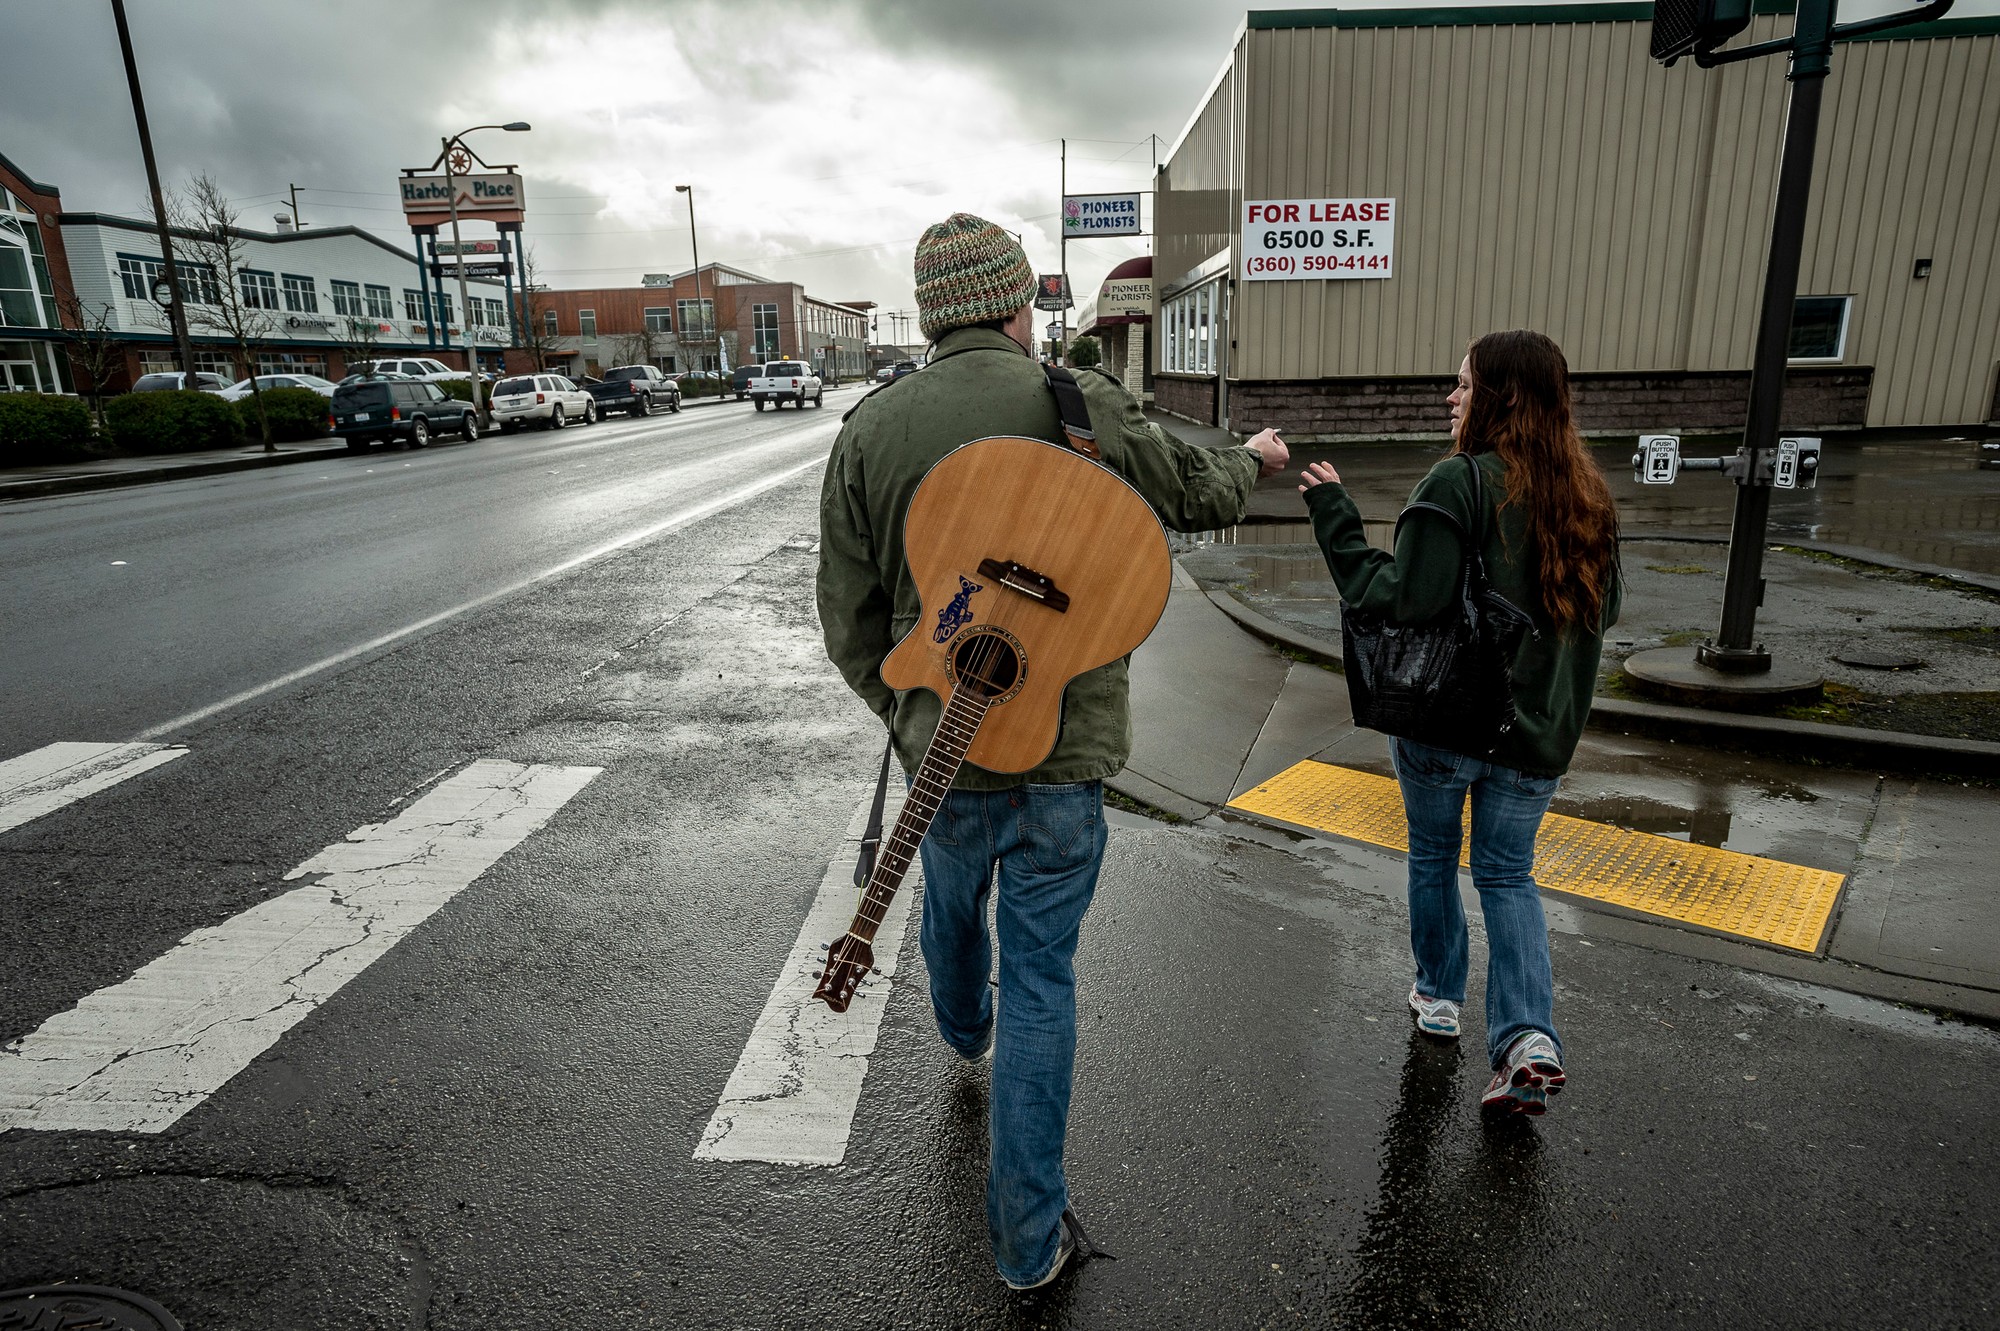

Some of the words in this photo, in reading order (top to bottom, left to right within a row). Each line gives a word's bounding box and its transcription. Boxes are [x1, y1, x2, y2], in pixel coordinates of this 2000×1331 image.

[473, 181, 514, 197] Place
[1081, 200, 1135, 214] PIONEER
[1248, 204, 1300, 223] FOR
[1309, 202, 1390, 222] LEASE
[1082, 216, 1135, 229] FLORISTS
[1263, 229, 1324, 249] 6500
[1332, 229, 1374, 247] S.F.
[1246, 256, 1296, 276] (360)
[1302, 255, 1389, 271] 590-4141
[1111, 284, 1151, 293] PIONEER
[1111, 293, 1152, 302] FLORISTS
